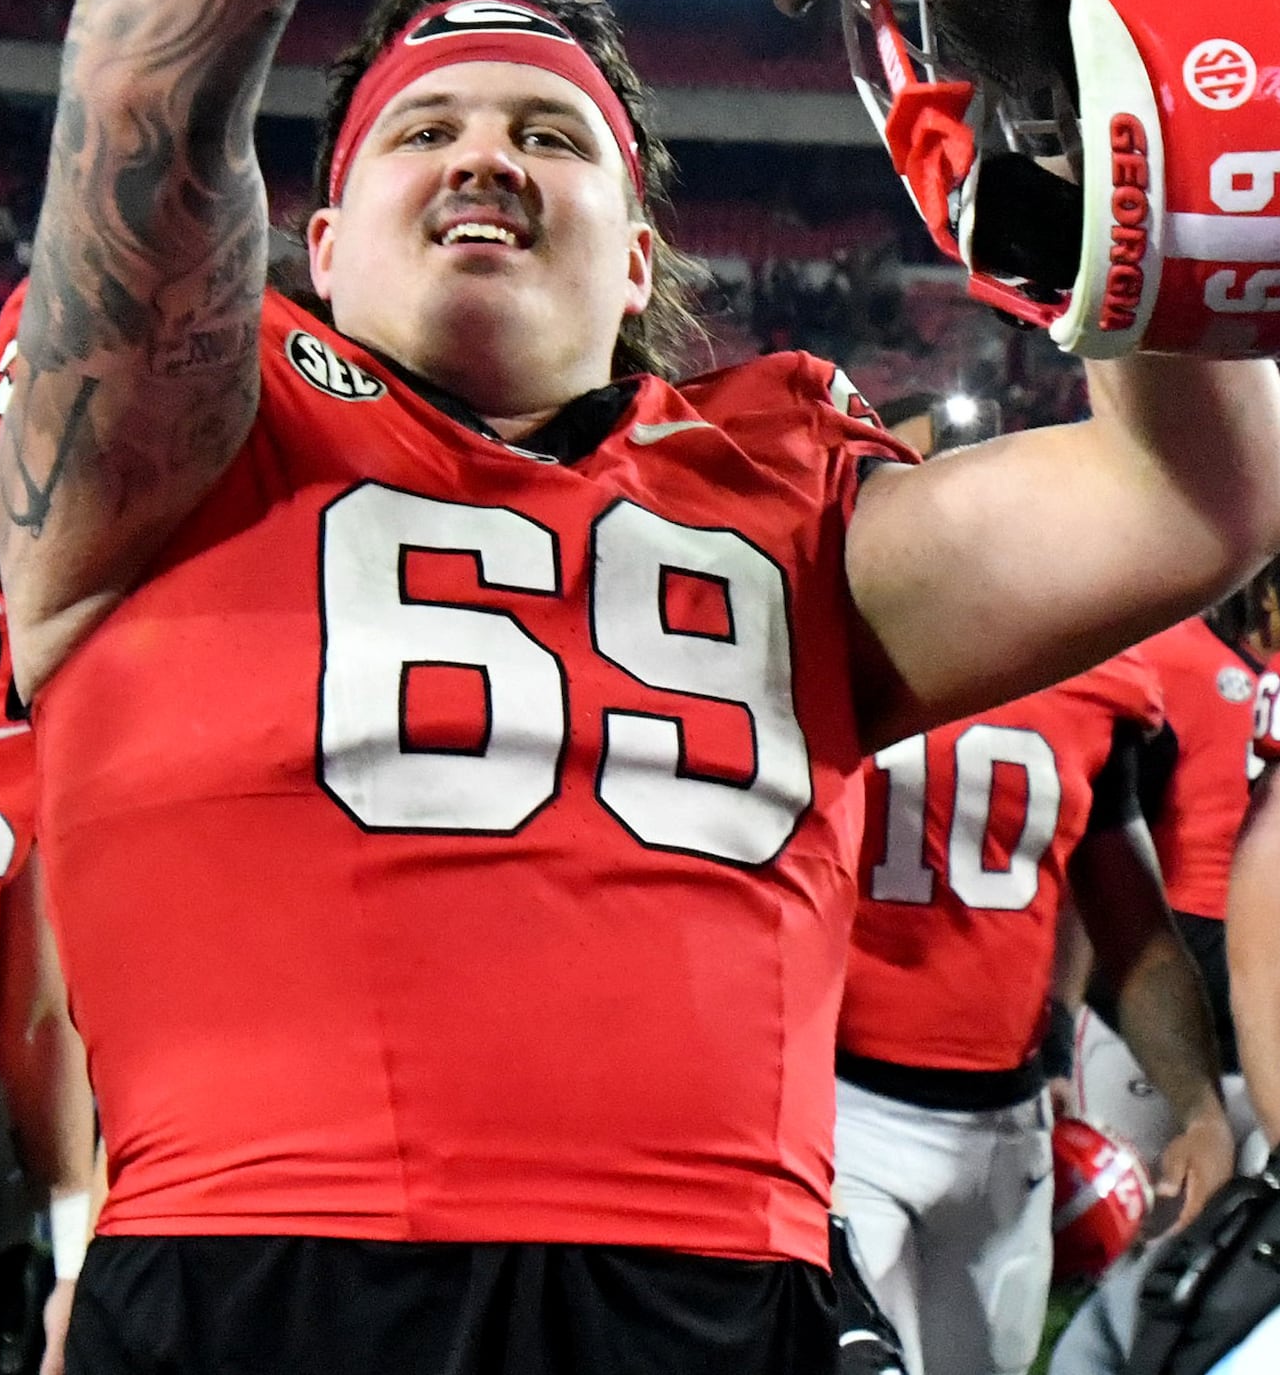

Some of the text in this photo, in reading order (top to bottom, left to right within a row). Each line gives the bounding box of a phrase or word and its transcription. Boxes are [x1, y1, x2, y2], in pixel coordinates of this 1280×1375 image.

[1194, 48, 1248, 101] SEC
[295, 333, 380, 397] SEC
[320, 478, 813, 870] 69
[870, 724, 1062, 912] 10
